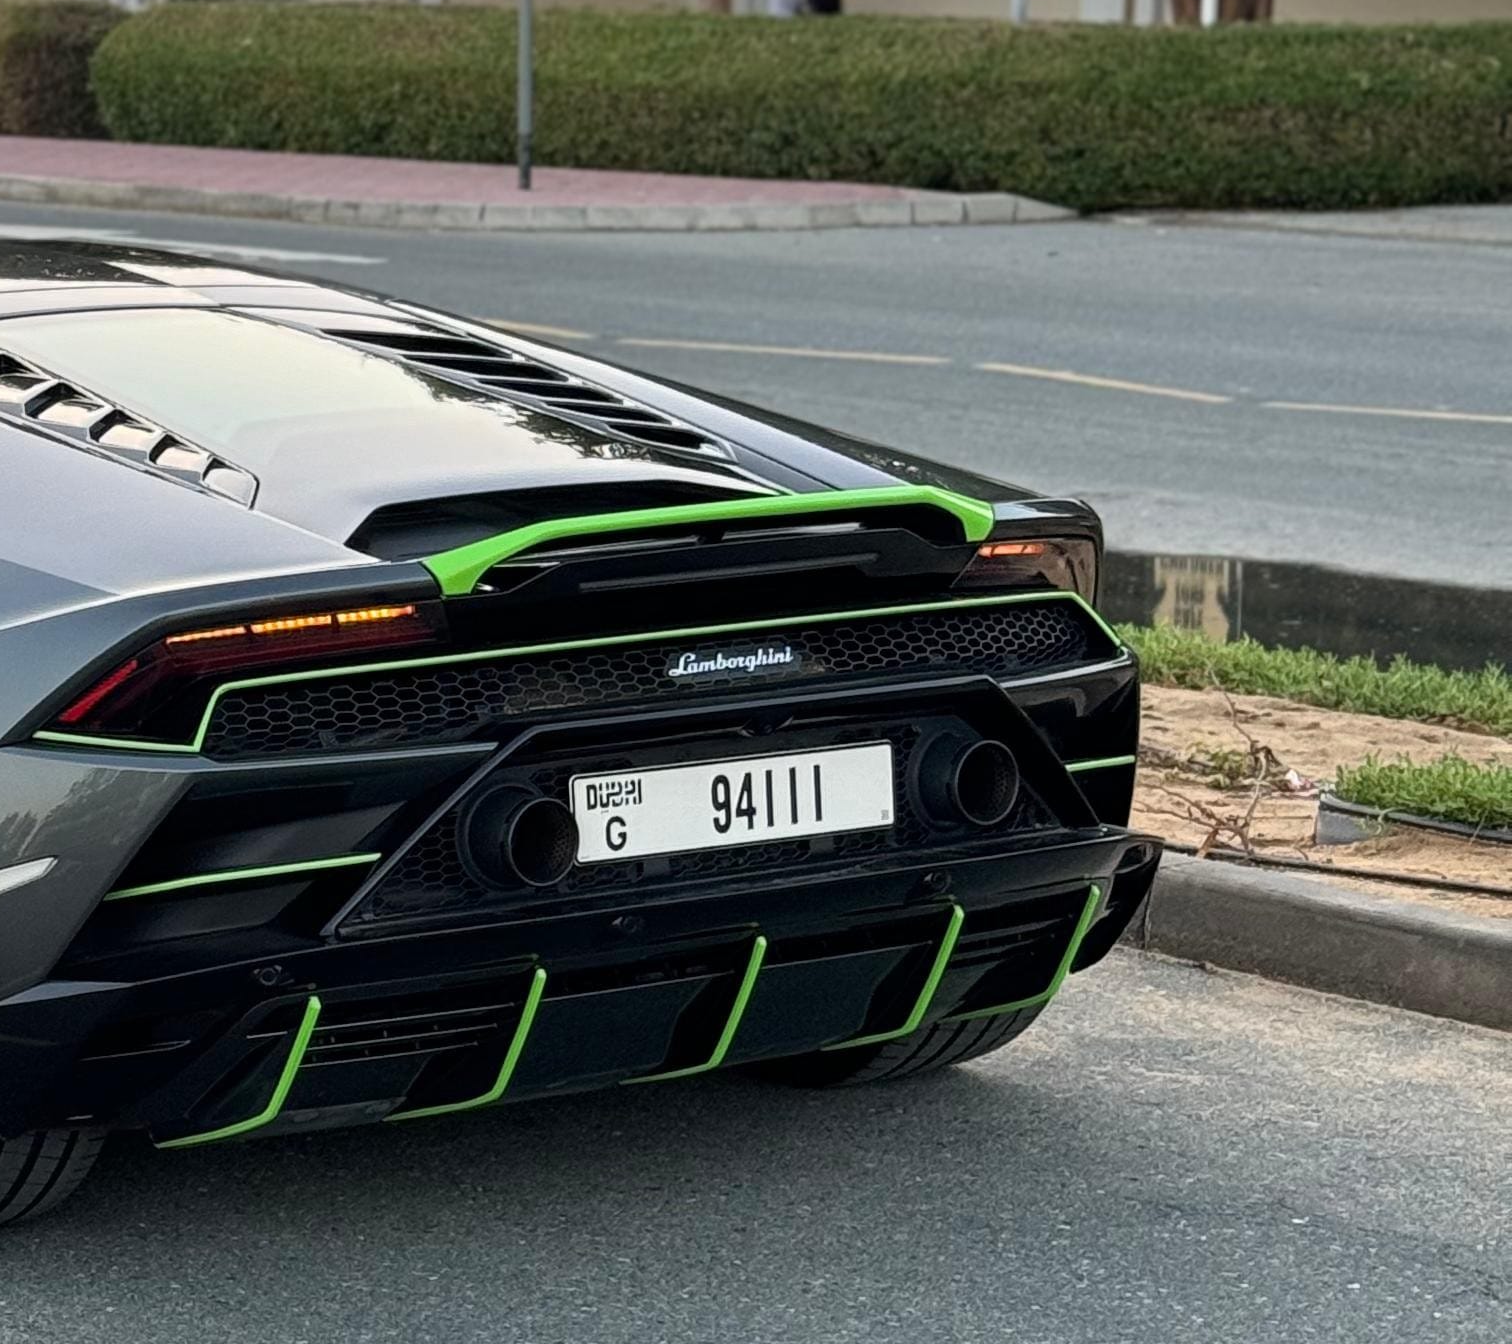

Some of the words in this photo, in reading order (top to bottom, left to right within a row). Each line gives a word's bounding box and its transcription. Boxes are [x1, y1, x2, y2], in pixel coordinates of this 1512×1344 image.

[668, 646, 794, 676] Lamborghini
[711, 764, 823, 834] 94111
[606, 816, 627, 851] G
